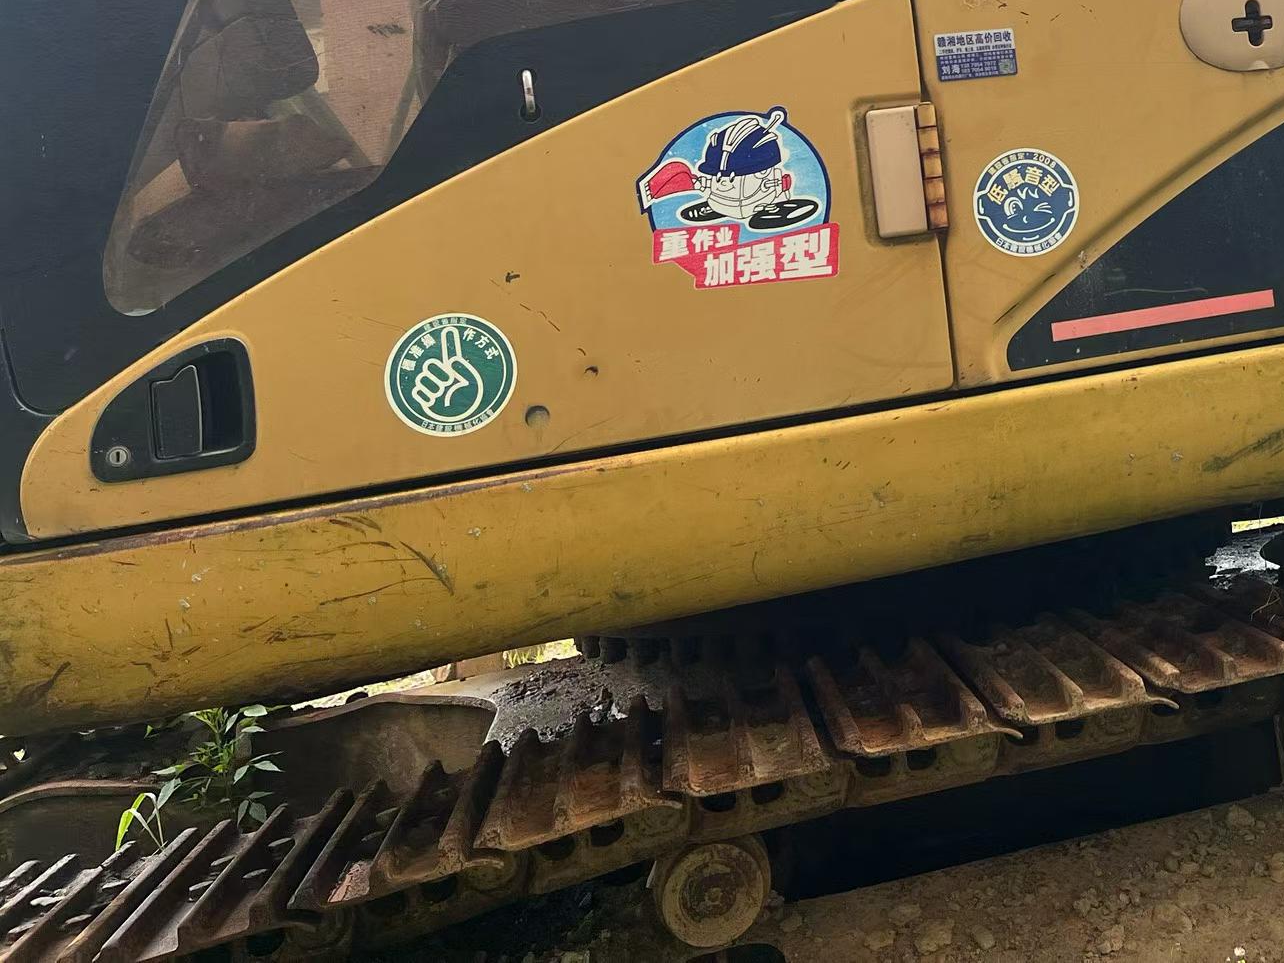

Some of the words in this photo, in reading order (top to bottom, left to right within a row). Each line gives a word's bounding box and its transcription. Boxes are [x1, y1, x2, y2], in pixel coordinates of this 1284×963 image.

[1032, 153, 1057, 169] 2008
[659, 226, 734, 261] 重作业
[703, 227, 833, 286] 加强型
